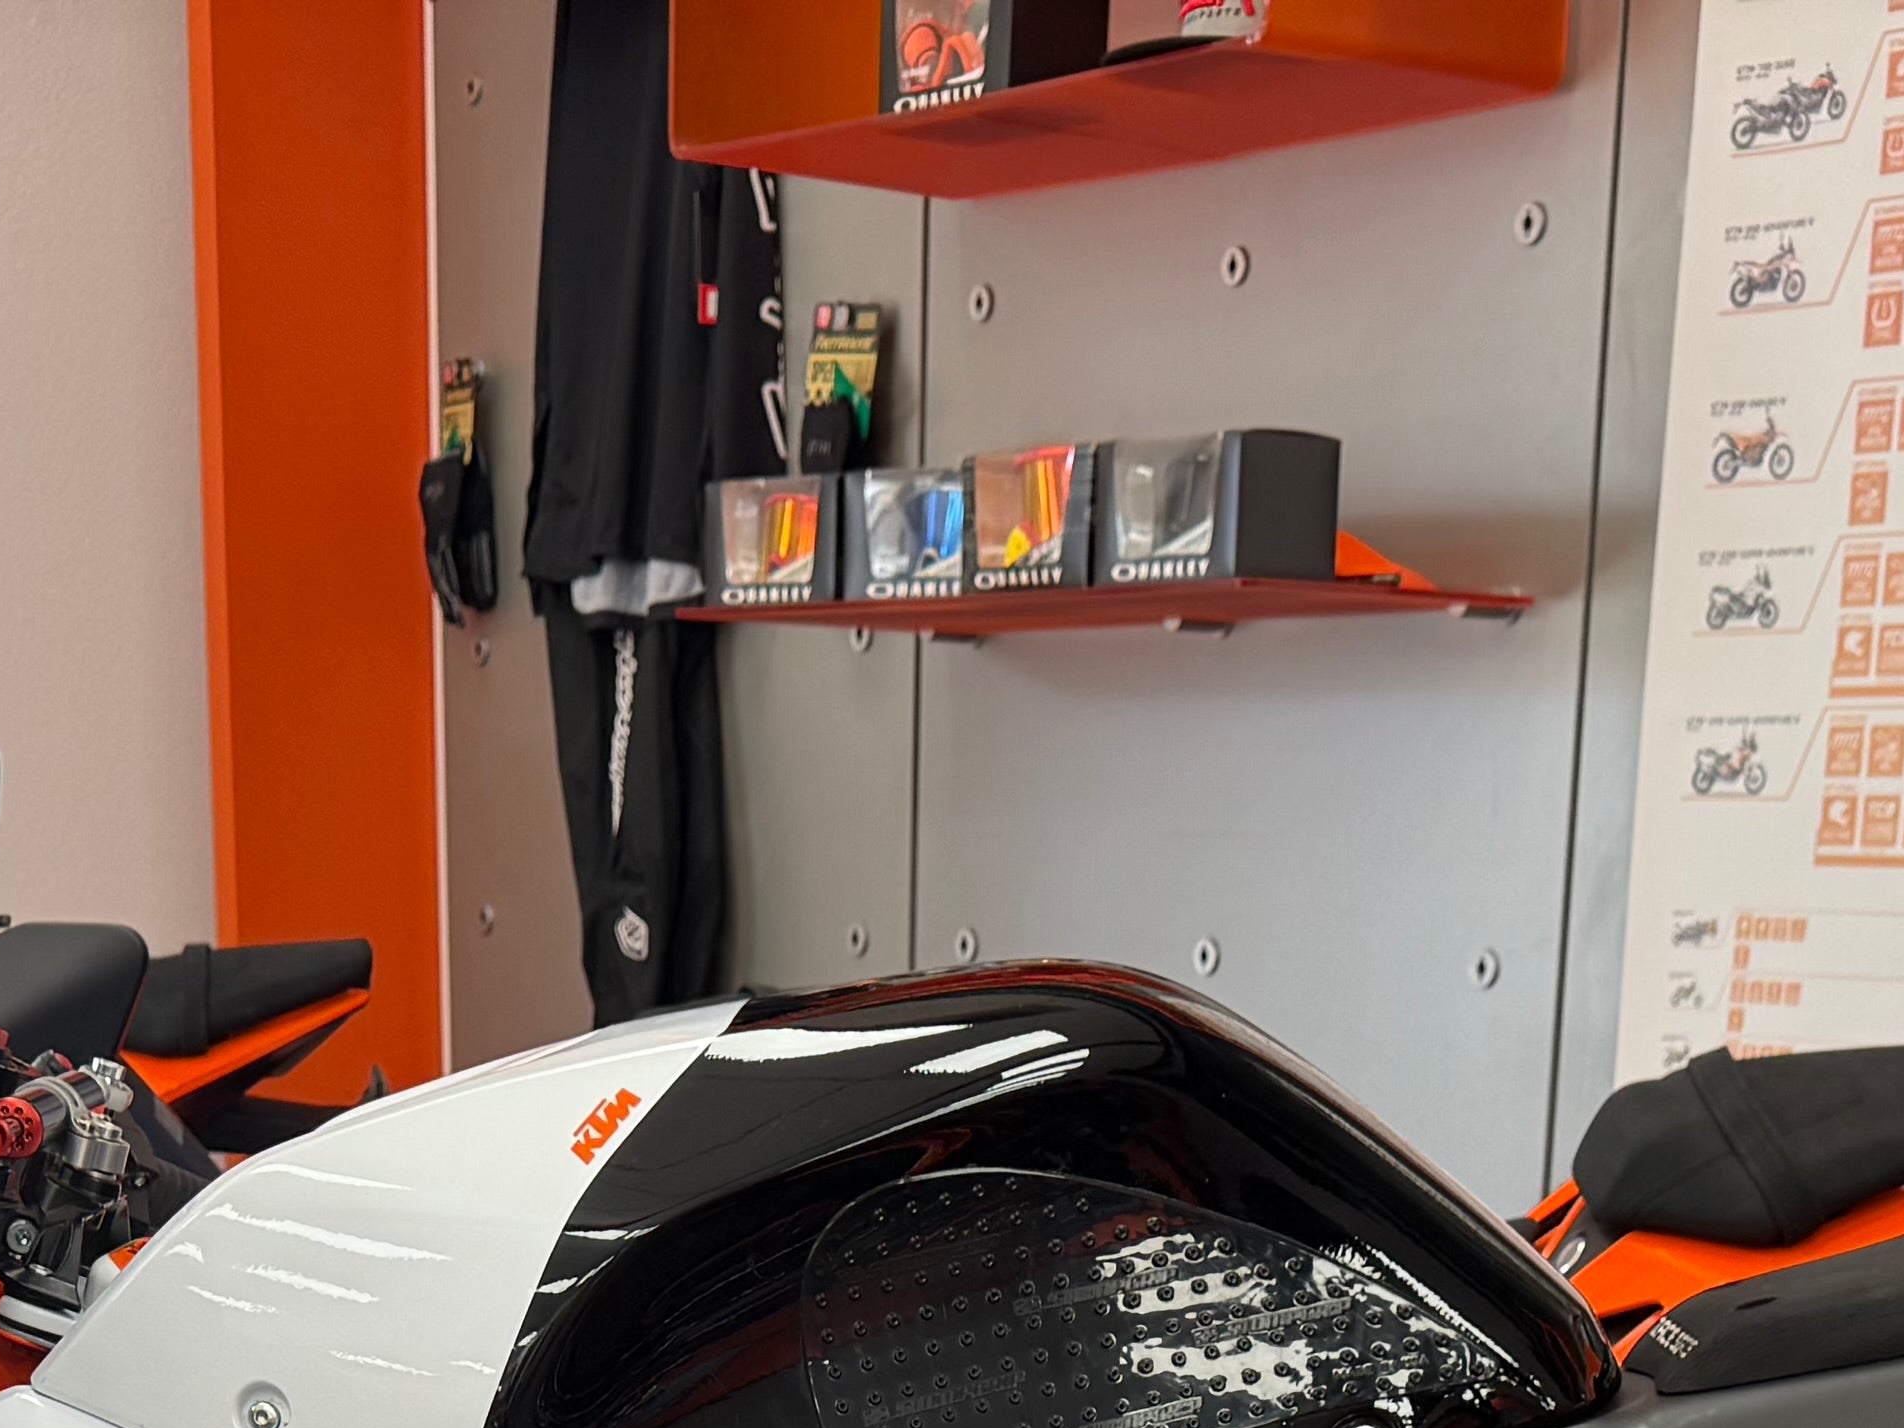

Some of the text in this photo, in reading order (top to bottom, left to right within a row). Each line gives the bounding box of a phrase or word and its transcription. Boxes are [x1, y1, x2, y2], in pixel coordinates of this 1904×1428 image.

[893, 82, 985, 114] OAKLEY
[975, 567, 1063, 590] OAKLEY
[1111, 558, 1209, 582] OAKLEY
[721, 585, 812, 604] OAKLEY
[866, 580, 962, 599] OAKLE
[569, 1087, 642, 1166] KTM
